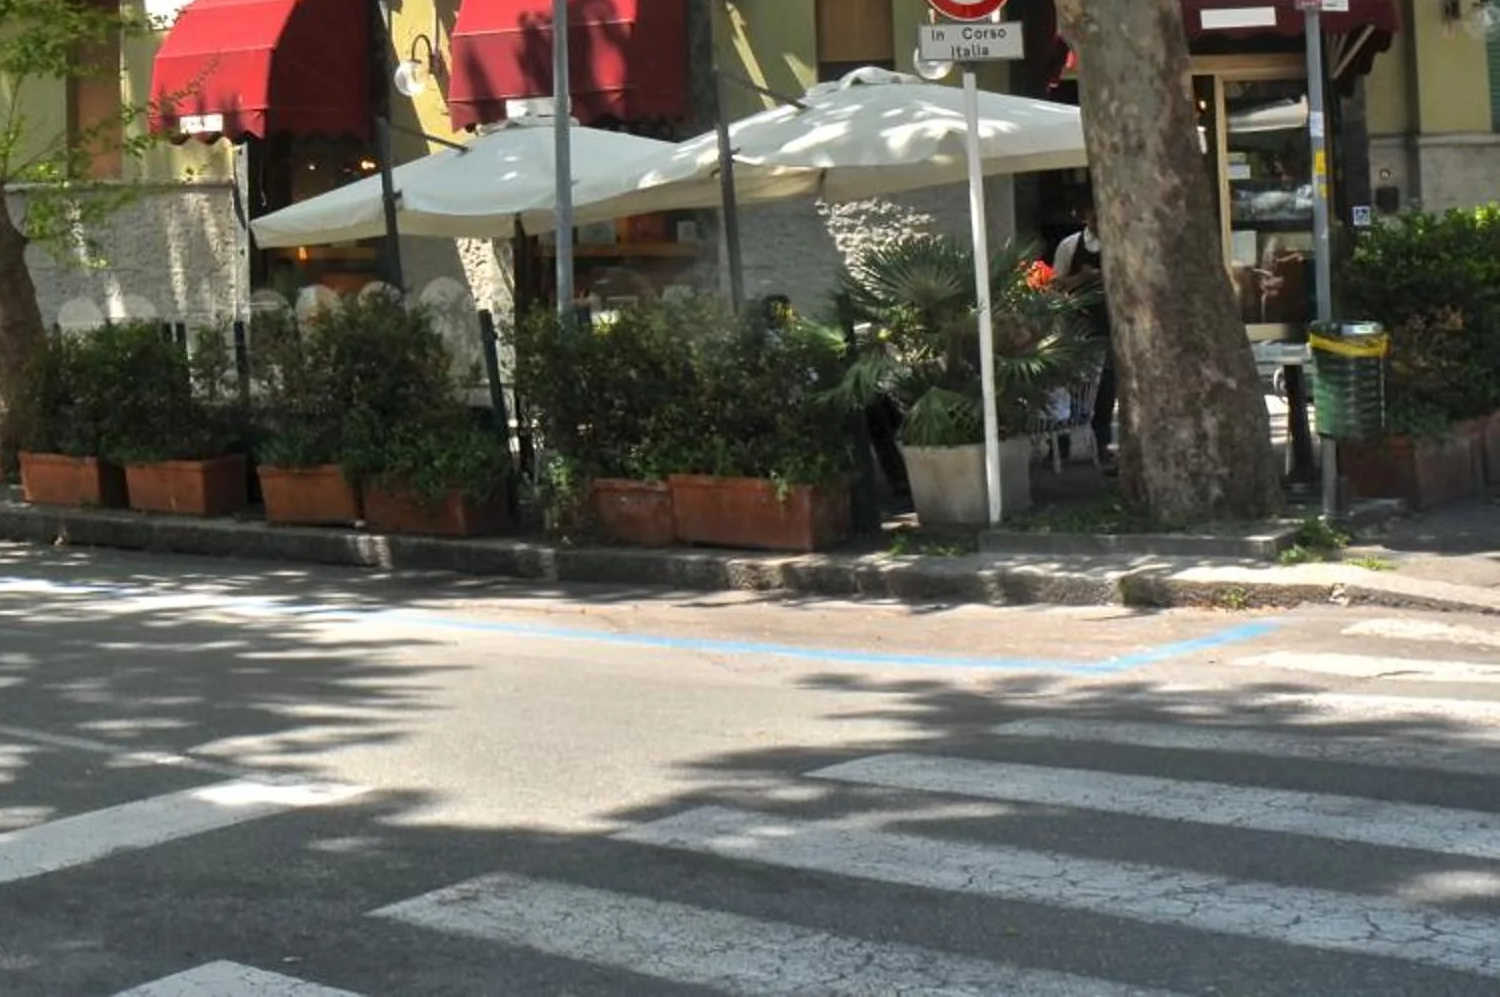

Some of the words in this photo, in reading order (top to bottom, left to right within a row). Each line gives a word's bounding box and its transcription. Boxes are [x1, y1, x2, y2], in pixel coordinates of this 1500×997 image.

[930, 29, 945, 42] In
[961, 26, 1007, 40] Corso
[950, 44, 989, 58] Italia
